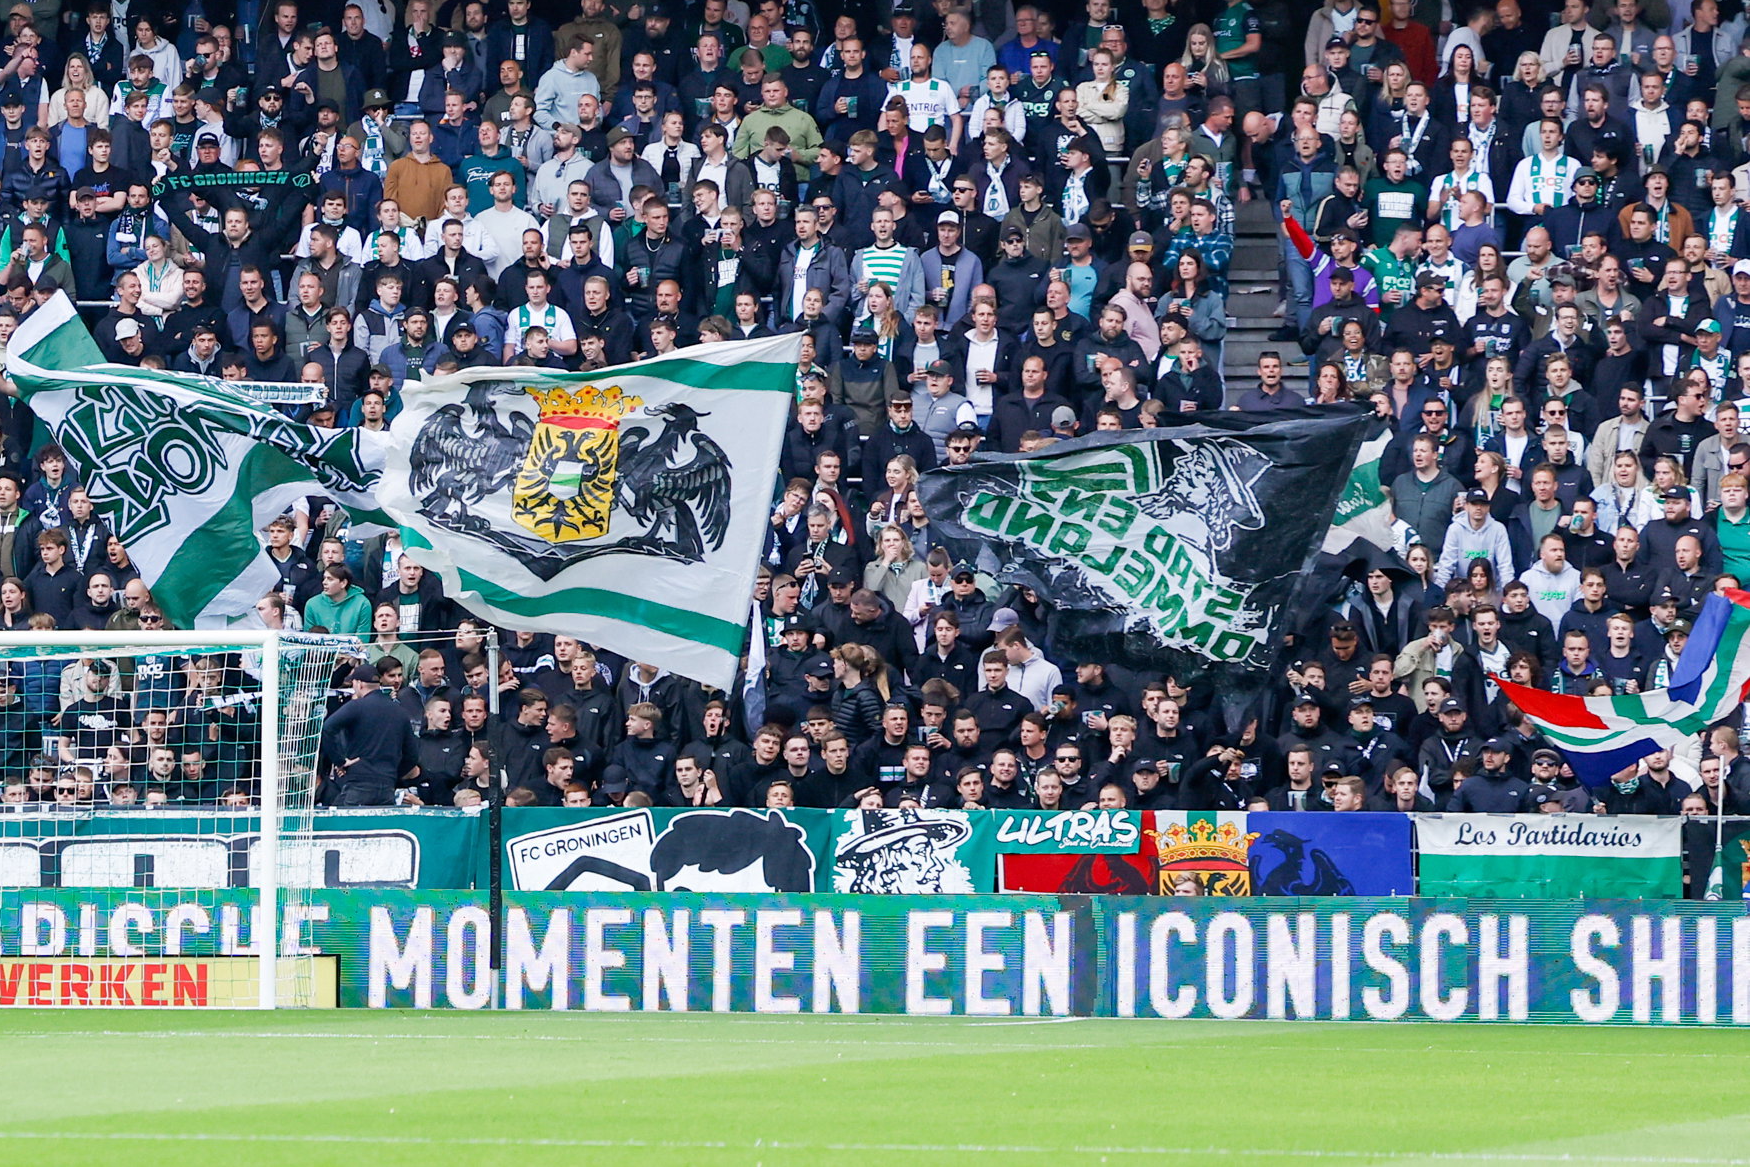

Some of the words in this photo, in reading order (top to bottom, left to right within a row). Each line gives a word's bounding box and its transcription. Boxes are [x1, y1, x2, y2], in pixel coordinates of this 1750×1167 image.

[167, 175, 192, 190] FC
[193, 171, 290, 187] GRONINGEN
[520, 846, 540, 863] FC
[545, 823, 642, 857] GRONINGEN
[996, 810, 1139, 845] ULTRAS
[1454, 822, 1497, 846] Los
[1507, 821, 1642, 847] Partidarios
[368, 906, 860, 1015] MOMENTEN
[906, 911, 1071, 1017] EEN
[1117, 912, 1529, 1021] ICONISCH
